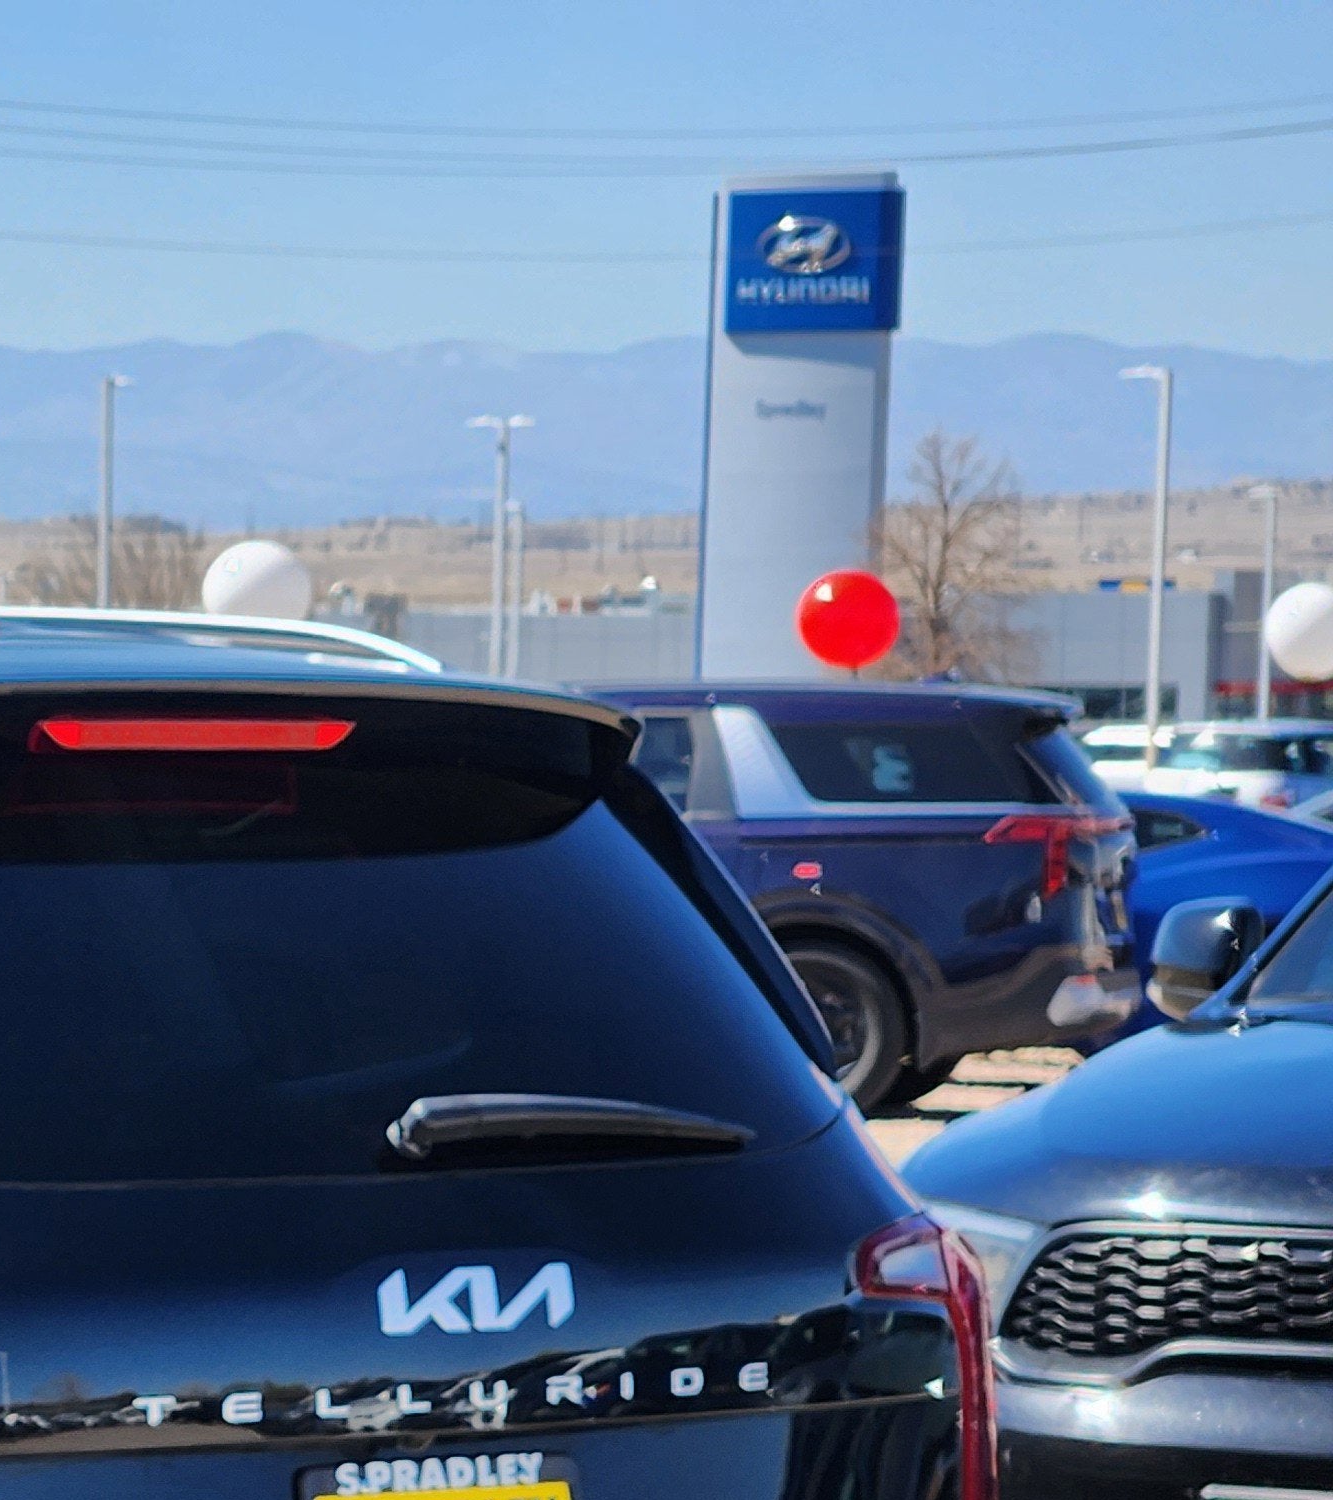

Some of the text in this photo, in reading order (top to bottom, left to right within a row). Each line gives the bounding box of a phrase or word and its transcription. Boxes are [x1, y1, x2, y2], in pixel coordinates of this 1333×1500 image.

[378, 1261, 575, 1337] KIA
[132, 1361, 769, 1427] TELLURIDE
[335, 1452, 543, 1495] SPRADLEY
